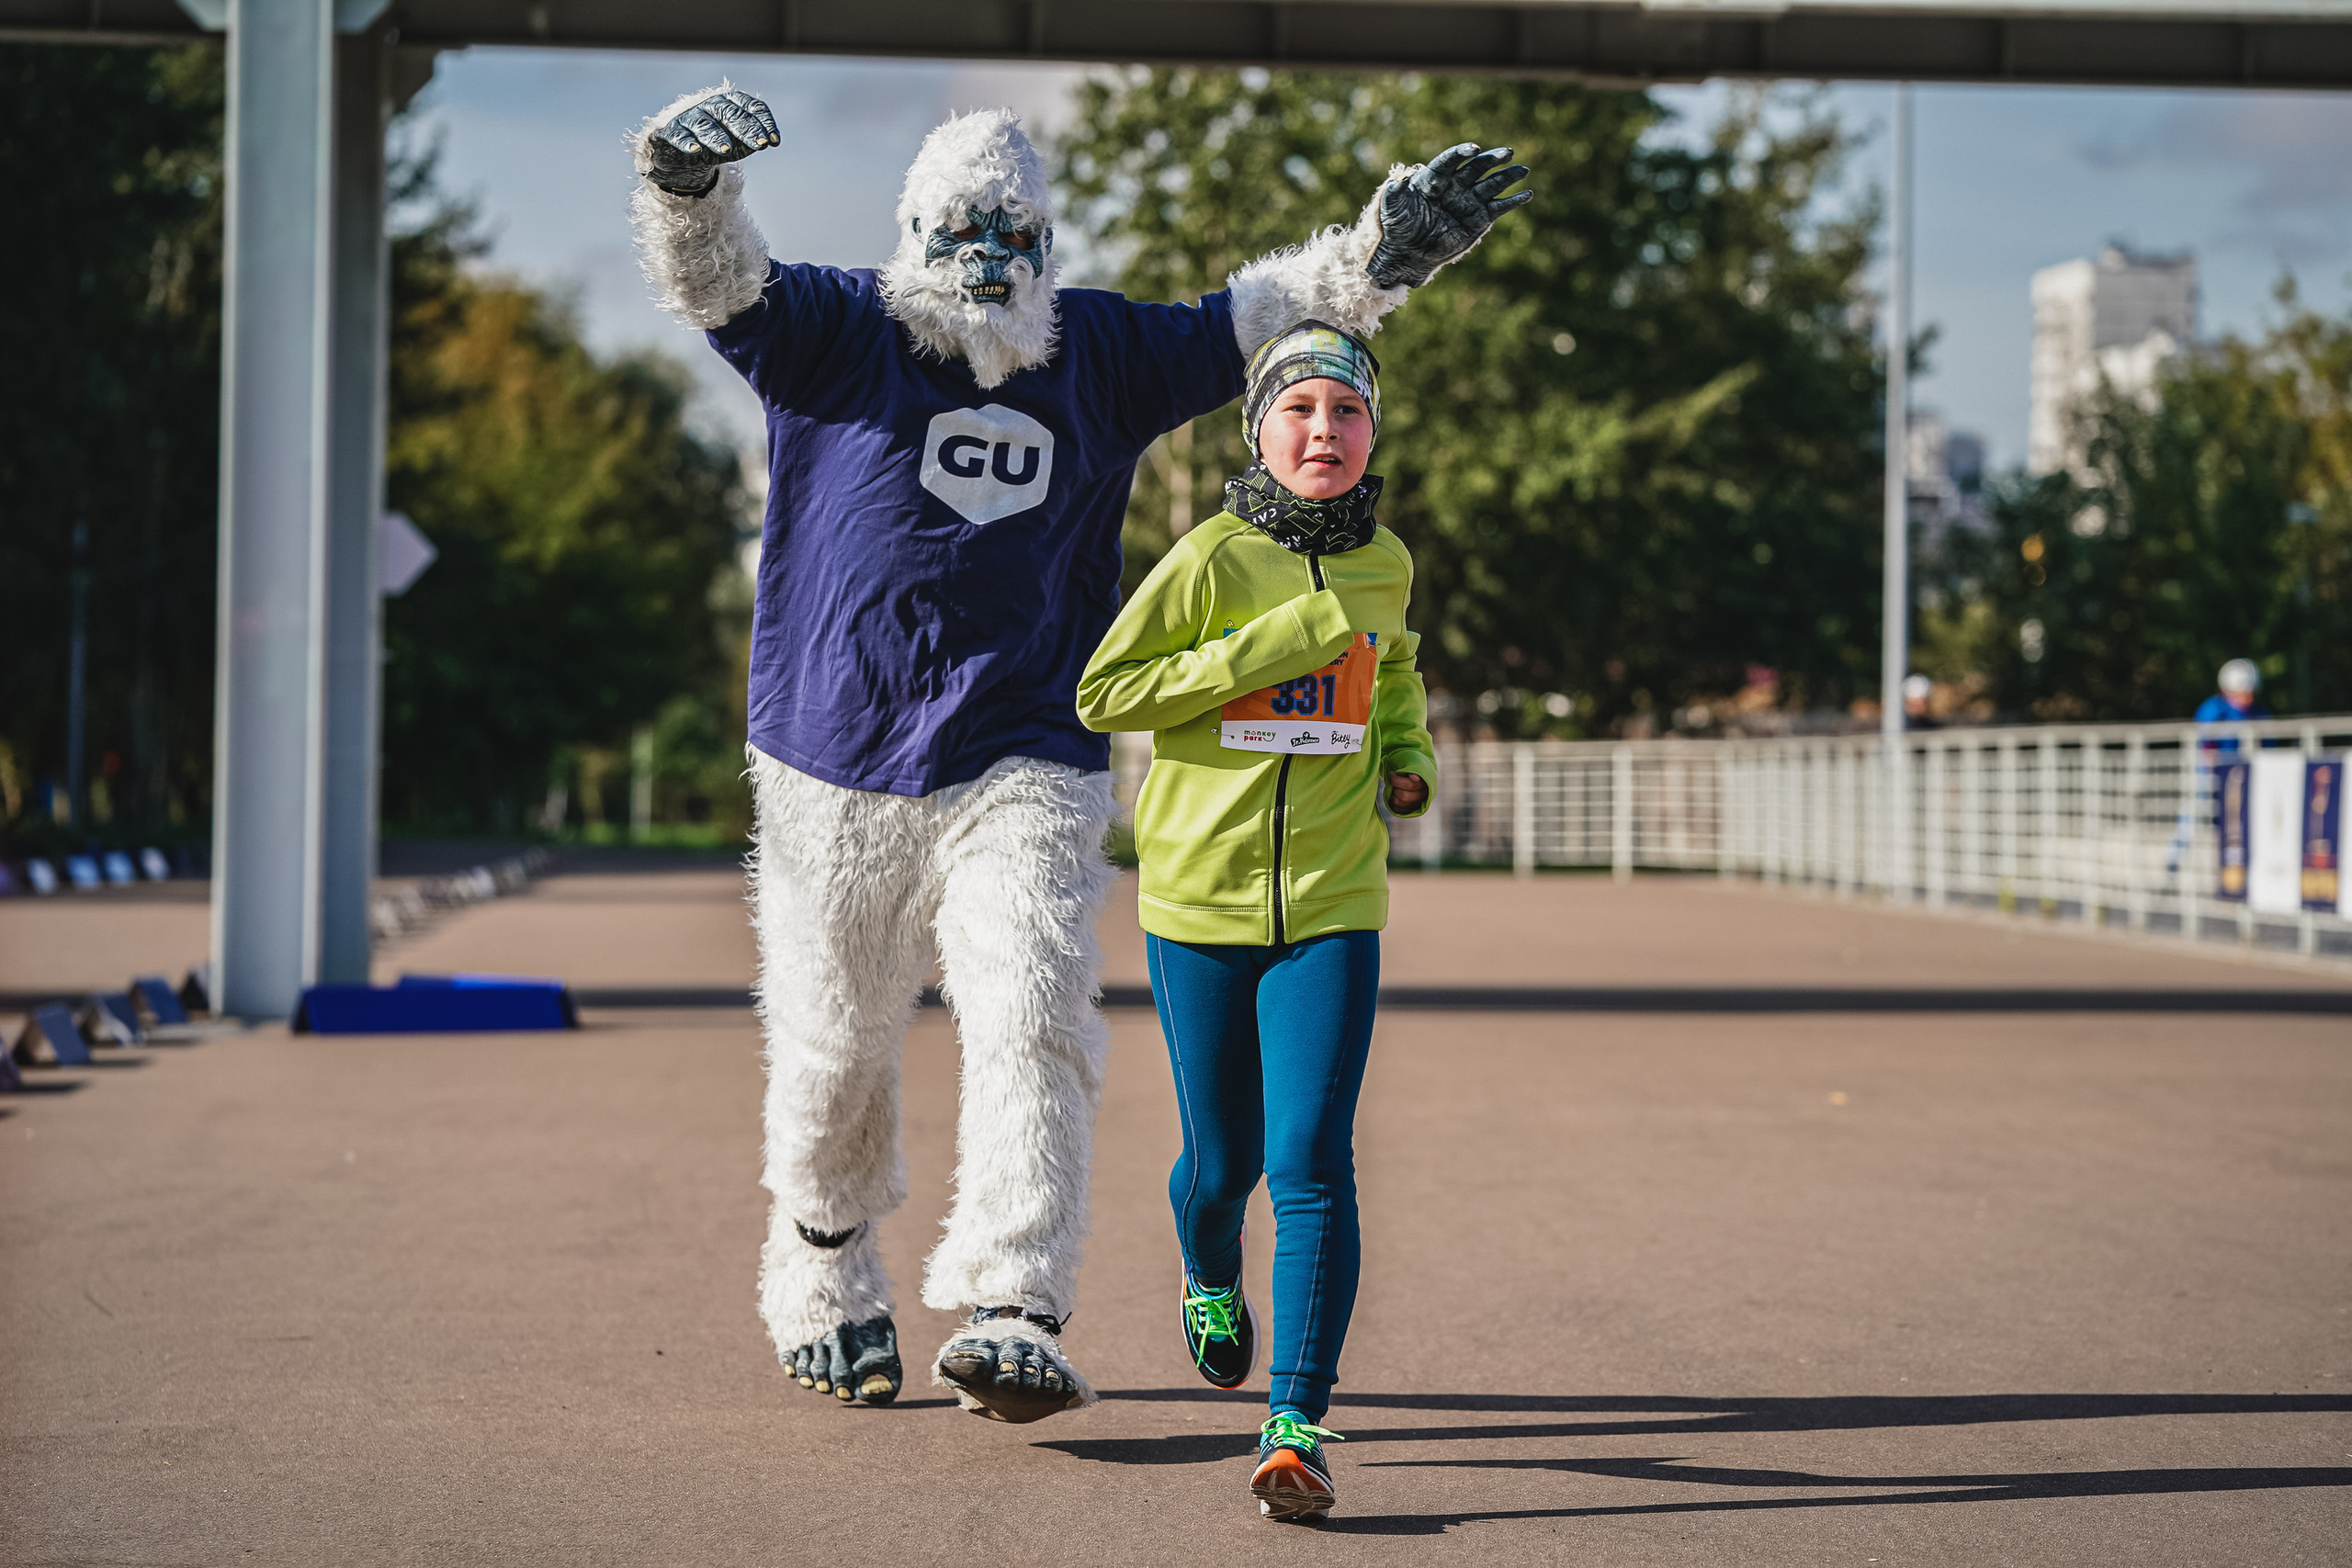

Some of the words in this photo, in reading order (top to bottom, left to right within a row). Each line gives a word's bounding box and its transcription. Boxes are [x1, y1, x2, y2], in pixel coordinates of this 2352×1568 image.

[937, 434, 1040, 485] GU
[1271, 673, 1336, 716] 331
[1244, 730, 1276, 742] monkey
